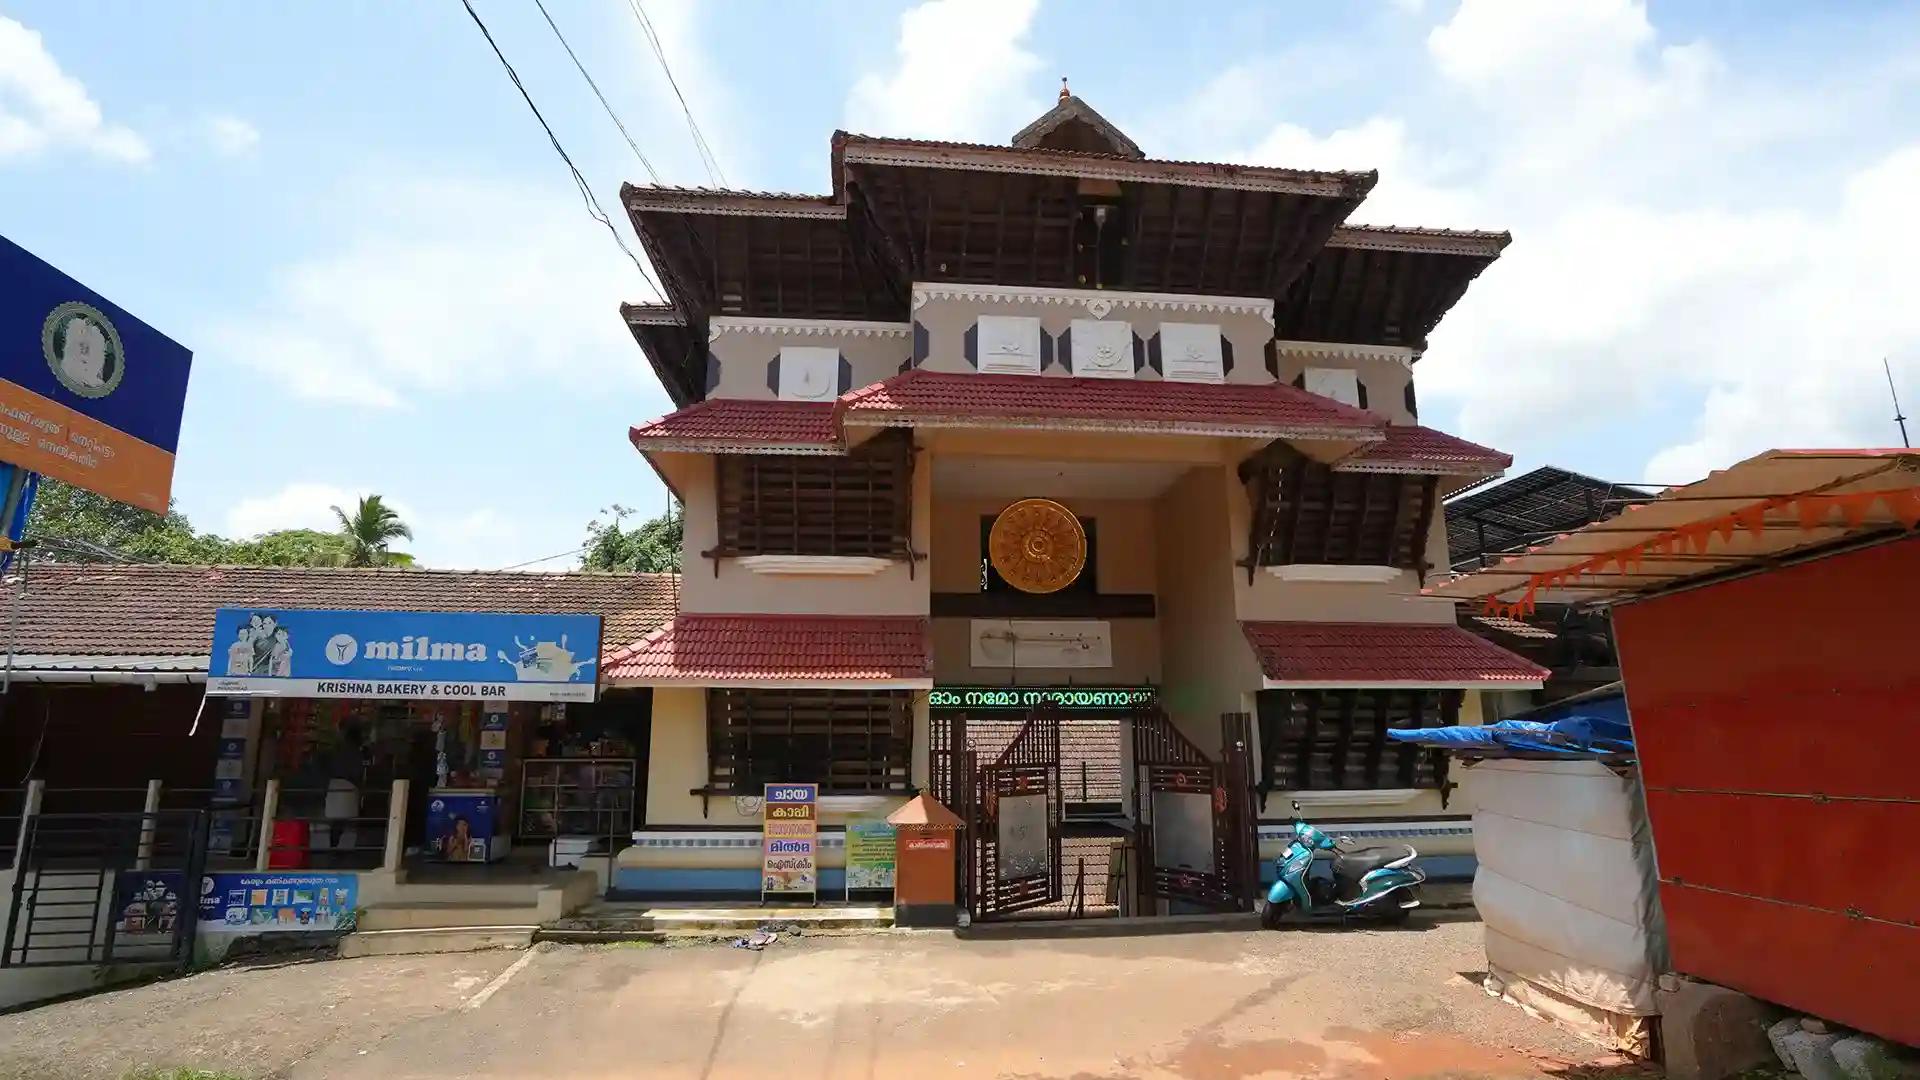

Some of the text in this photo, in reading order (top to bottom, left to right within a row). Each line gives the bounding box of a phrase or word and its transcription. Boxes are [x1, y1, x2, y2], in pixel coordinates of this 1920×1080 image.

[364, 636, 488, 662] milma
[317, 682, 506, 697] KRISHNA BAKERY & COOL BAR
[928, 691, 961, 705] ഓം
[965, 691, 1019, 705] നമോ
[774, 789, 808, 800] ചായ
[772, 805, 809, 818] കാപ്പി
[770, 841, 810, 853] മിൽമ
